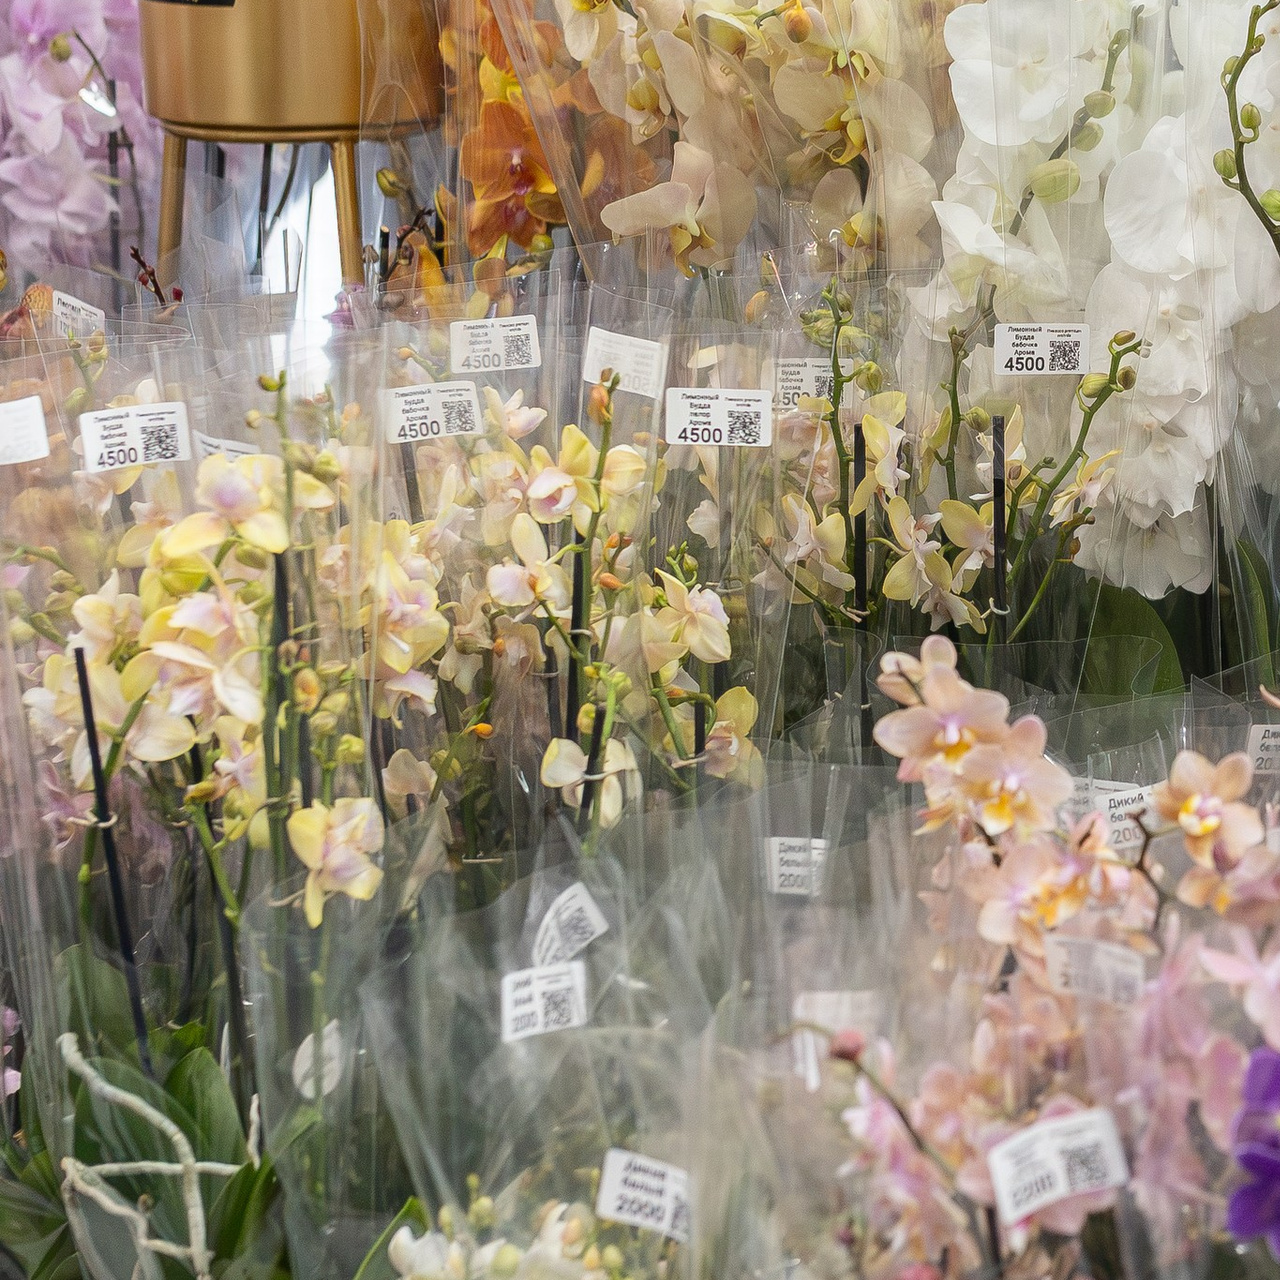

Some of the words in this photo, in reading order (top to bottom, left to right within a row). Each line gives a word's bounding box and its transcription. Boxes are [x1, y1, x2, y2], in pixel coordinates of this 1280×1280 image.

[461, 353, 501, 369] 4500
[1003, 356, 1045, 372] 4500
[397, 420, 441, 440] 4500
[678, 427, 723, 443] 4500
[97, 447, 138, 469] 4500
[1108, 792, 1145, 812] Дикий
[1112, 825, 1143, 845] 200
[616, 1192, 667, 1224] 2000
